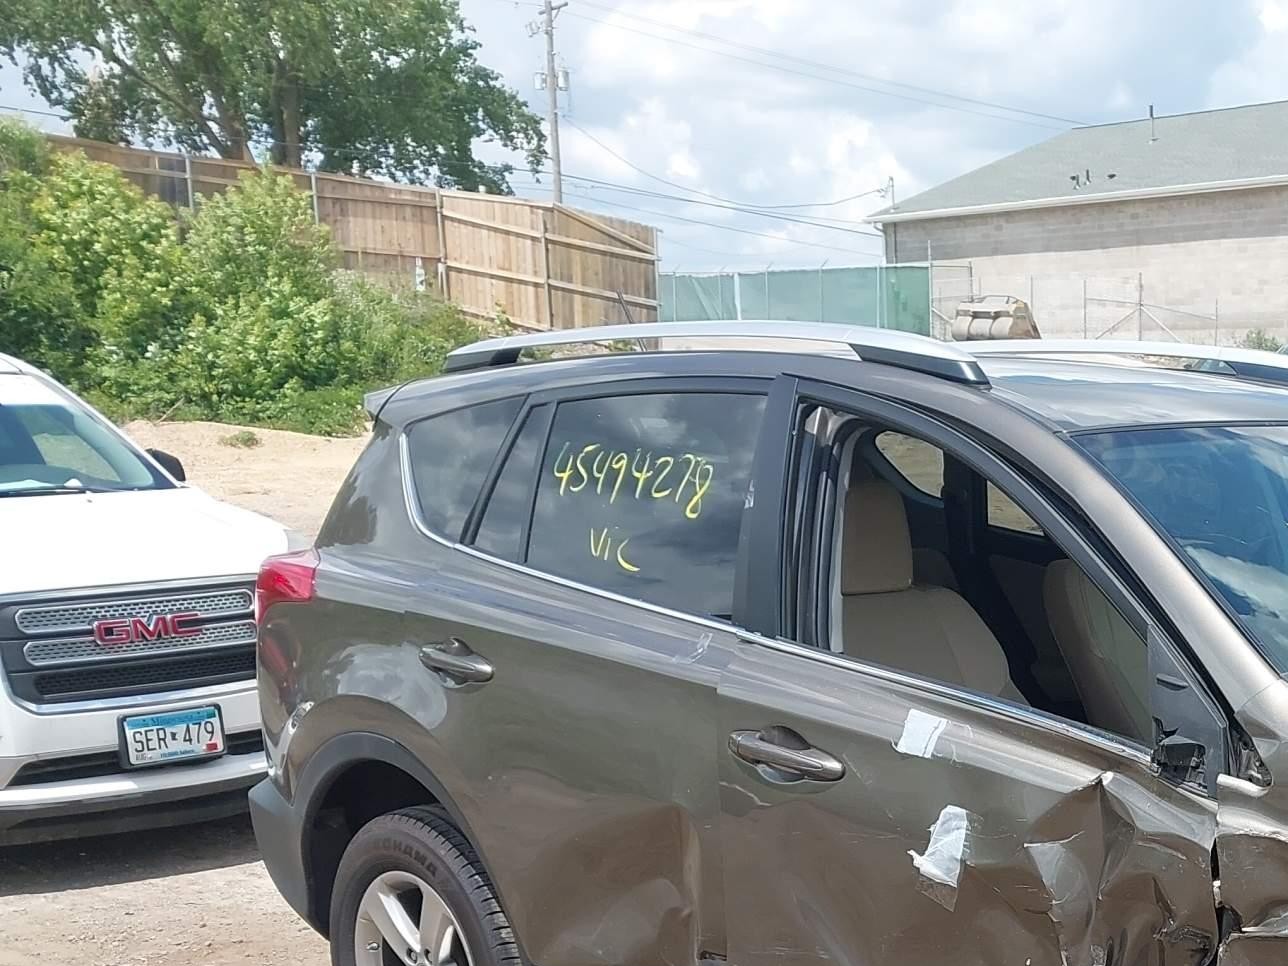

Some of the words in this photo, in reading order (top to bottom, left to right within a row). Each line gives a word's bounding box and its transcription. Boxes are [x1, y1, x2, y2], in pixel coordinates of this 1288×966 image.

[554, 441, 714, 518] 45494278
[94, 611, 203, 645] GMC
[133, 727, 170, 753] SER
[183, 720, 215, 745] 479
